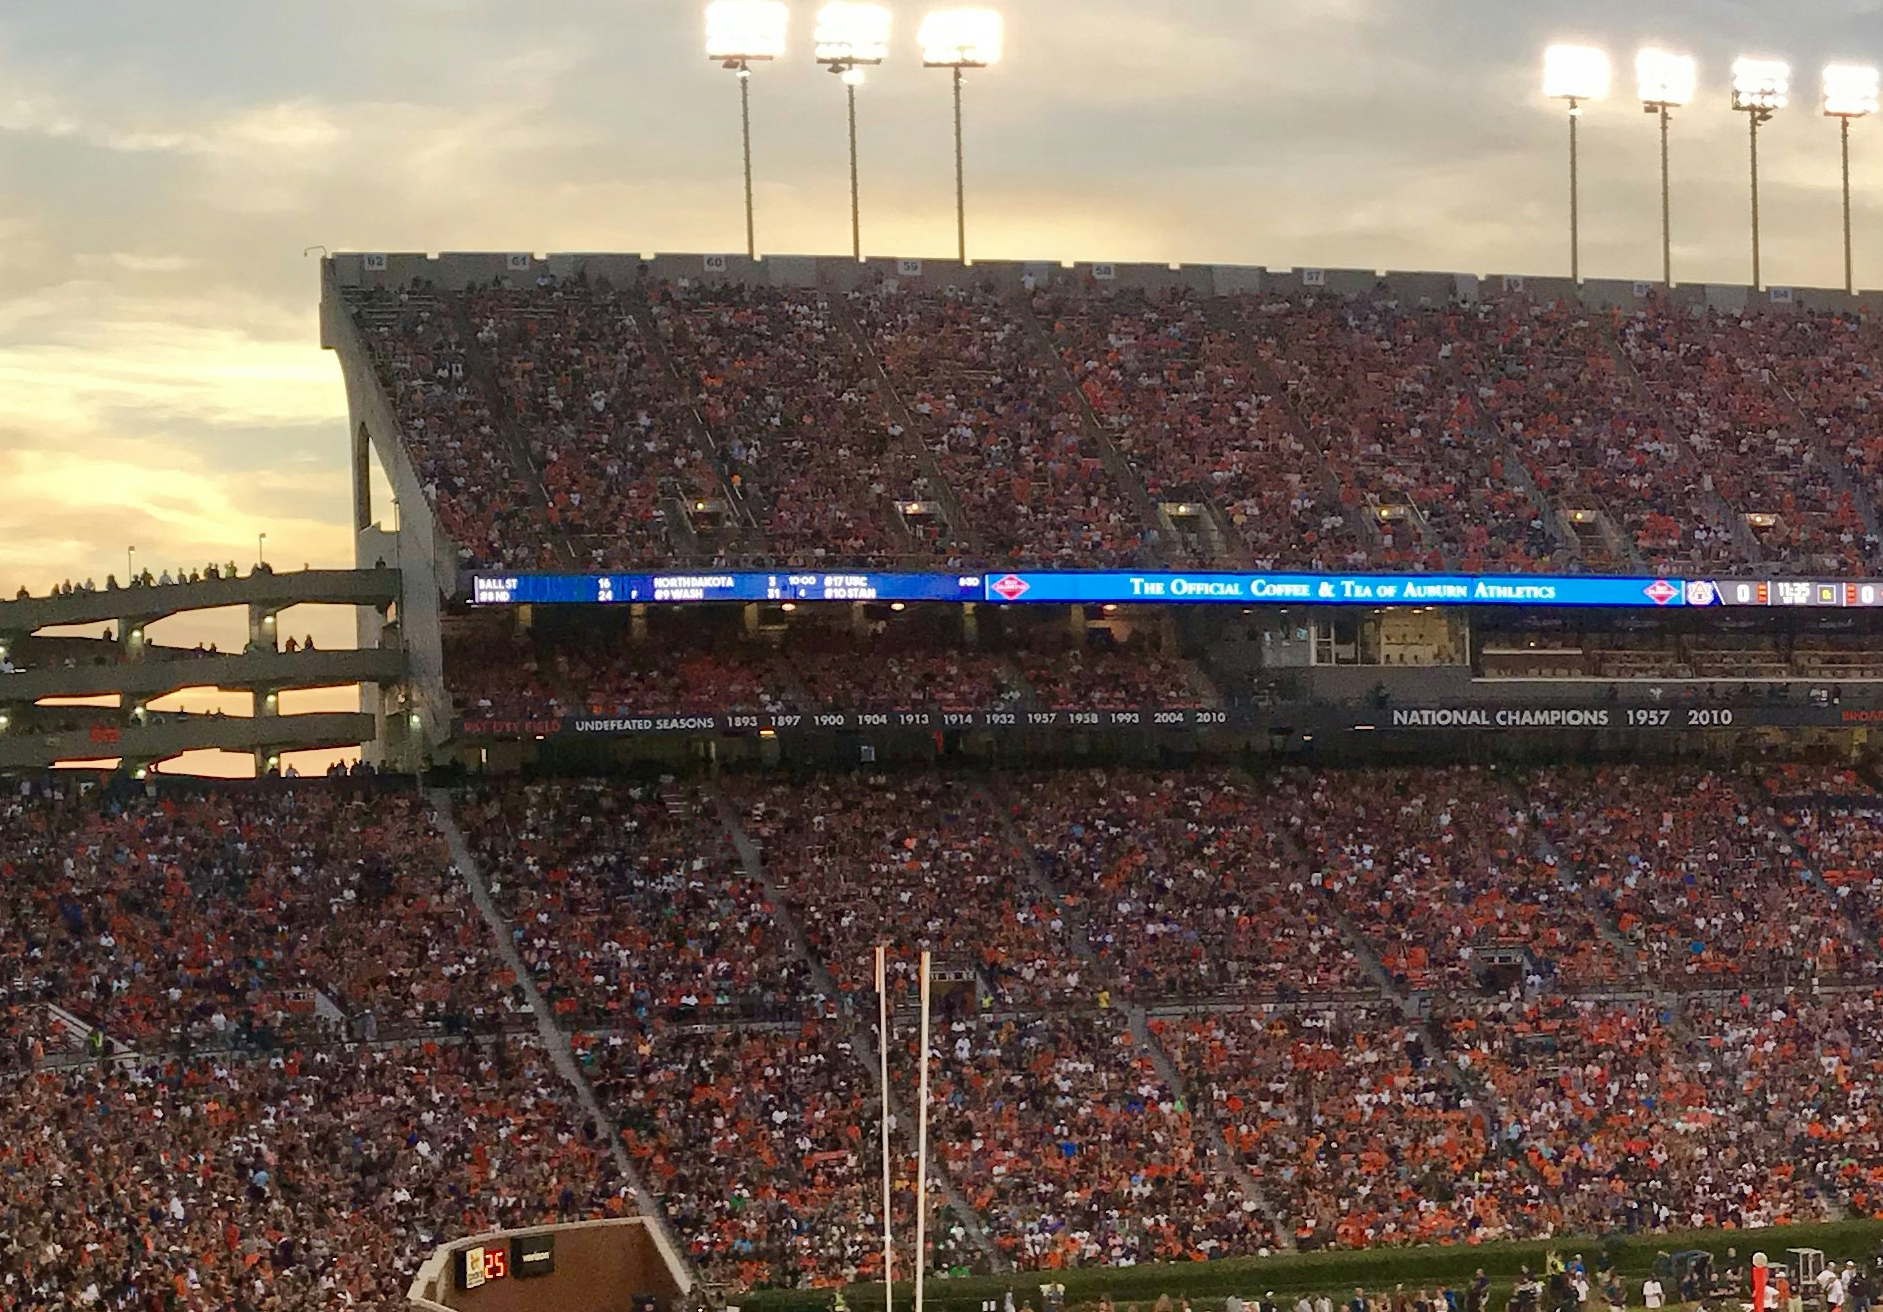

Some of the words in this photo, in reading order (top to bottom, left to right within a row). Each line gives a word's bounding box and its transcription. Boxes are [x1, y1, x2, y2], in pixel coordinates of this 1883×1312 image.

[479, 579, 505, 589] BALL
[506, 578, 518, 589] ST
[598, 577, 611, 589] 16
[654, 577, 691, 588] NORTH
[691, 576, 734, 588] DAKOTA
[769, 576, 777, 587] 3
[788, 576, 816, 586] 10:00
[845, 576, 868, 587] USC
[1318, 581, 1335, 597] &
[495, 591, 510, 602] ND
[598, 590, 613, 602] 24
[671, 589, 704, 600] WASH
[767, 589, 781, 600] 31
[798, 589, 806, 598] 4
[847, 588, 876, 599] STAN
[1737, 584, 1750, 602] 0
[1777, 582, 1811, 597] 11:35
[1861, 585, 1874, 603] 0
[575, 719, 652, 731] UNDEFEATED
[655, 717, 715, 730] SEASONS
[727, 715, 758, 727] 1893
[771, 715, 801, 727] 1897
[814, 715, 845, 726] 1900
[857, 714, 888, 725] 1904
[900, 714, 929, 725] 1913
[943, 714, 973, 725] 1914
[986, 713, 1016, 725] 1932
[1027, 713, 1057, 724] 1957
[1069, 713, 1099, 724] 1958
[1110, 713, 1140, 724] 1993
[1154, 712, 1184, 723] 2004
[1196, 712, 1226, 723] 2010
[1392, 709, 1491, 726] NATIONAL
[1495, 709, 1610, 726] CHAMPIONS
[1626, 709, 1670, 726] 1957
[1687, 709, 1733, 726] 2010
[485, 1251, 505, 1279] 25
